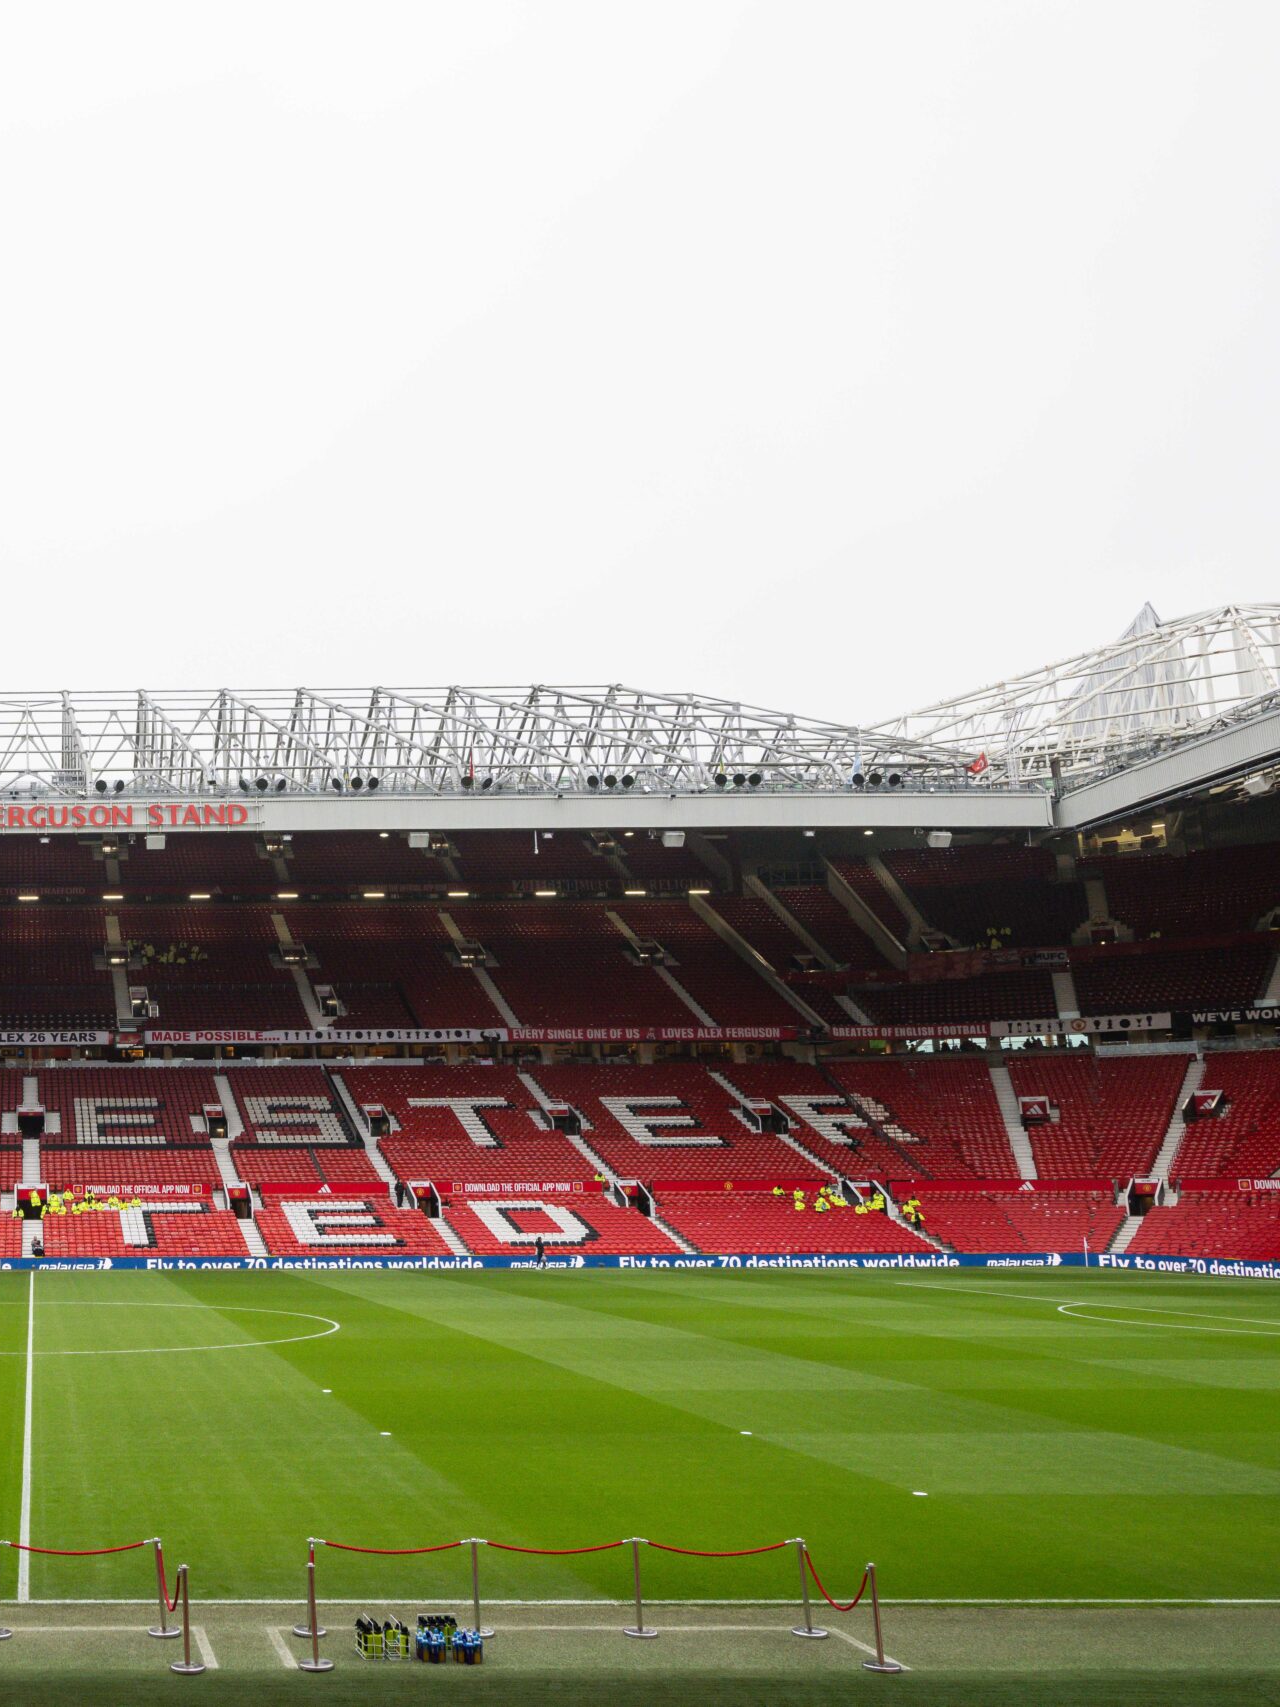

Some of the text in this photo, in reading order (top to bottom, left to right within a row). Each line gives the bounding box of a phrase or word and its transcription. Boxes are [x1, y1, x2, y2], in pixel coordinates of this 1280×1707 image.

[149, 804, 249, 826] STAND
[39, 887, 86, 895] TRAFFORD
[1192, 1011, 1240, 1023] WE'VE
[151, 1031, 191, 1042] MADE
[513, 1027, 780, 1039] EVERY SINGLE ONE OF US LOVES ALEX FERGUSON
[832, 1025, 987, 1037] GREATEST OF ENGLISH FOOTBALL
[30, 1033, 46, 1043] 26
[51, 1033, 97, 1042] YEARS
[121, 1185, 133, 1194] THE
[134, 1185, 161, 1194] OFFICIAL
[162, 1185, 174, 1193] APP
[175, 1185, 189, 1193] NOW
[465, 1182, 570, 1192] DOWNLOAD THE OFFICIAL APP NOW
[147, 1257, 483, 1270] Fly to over 70 destinations worldwide
[620, 1255, 960, 1268] Fly to over 70 destinations worldwide
[1099, 1254, 1130, 1268] Fly
[1134, 1256, 1156, 1270] to
[1158, 1261, 1186, 1272] over
[1188, 1259, 1206, 1273] 70
